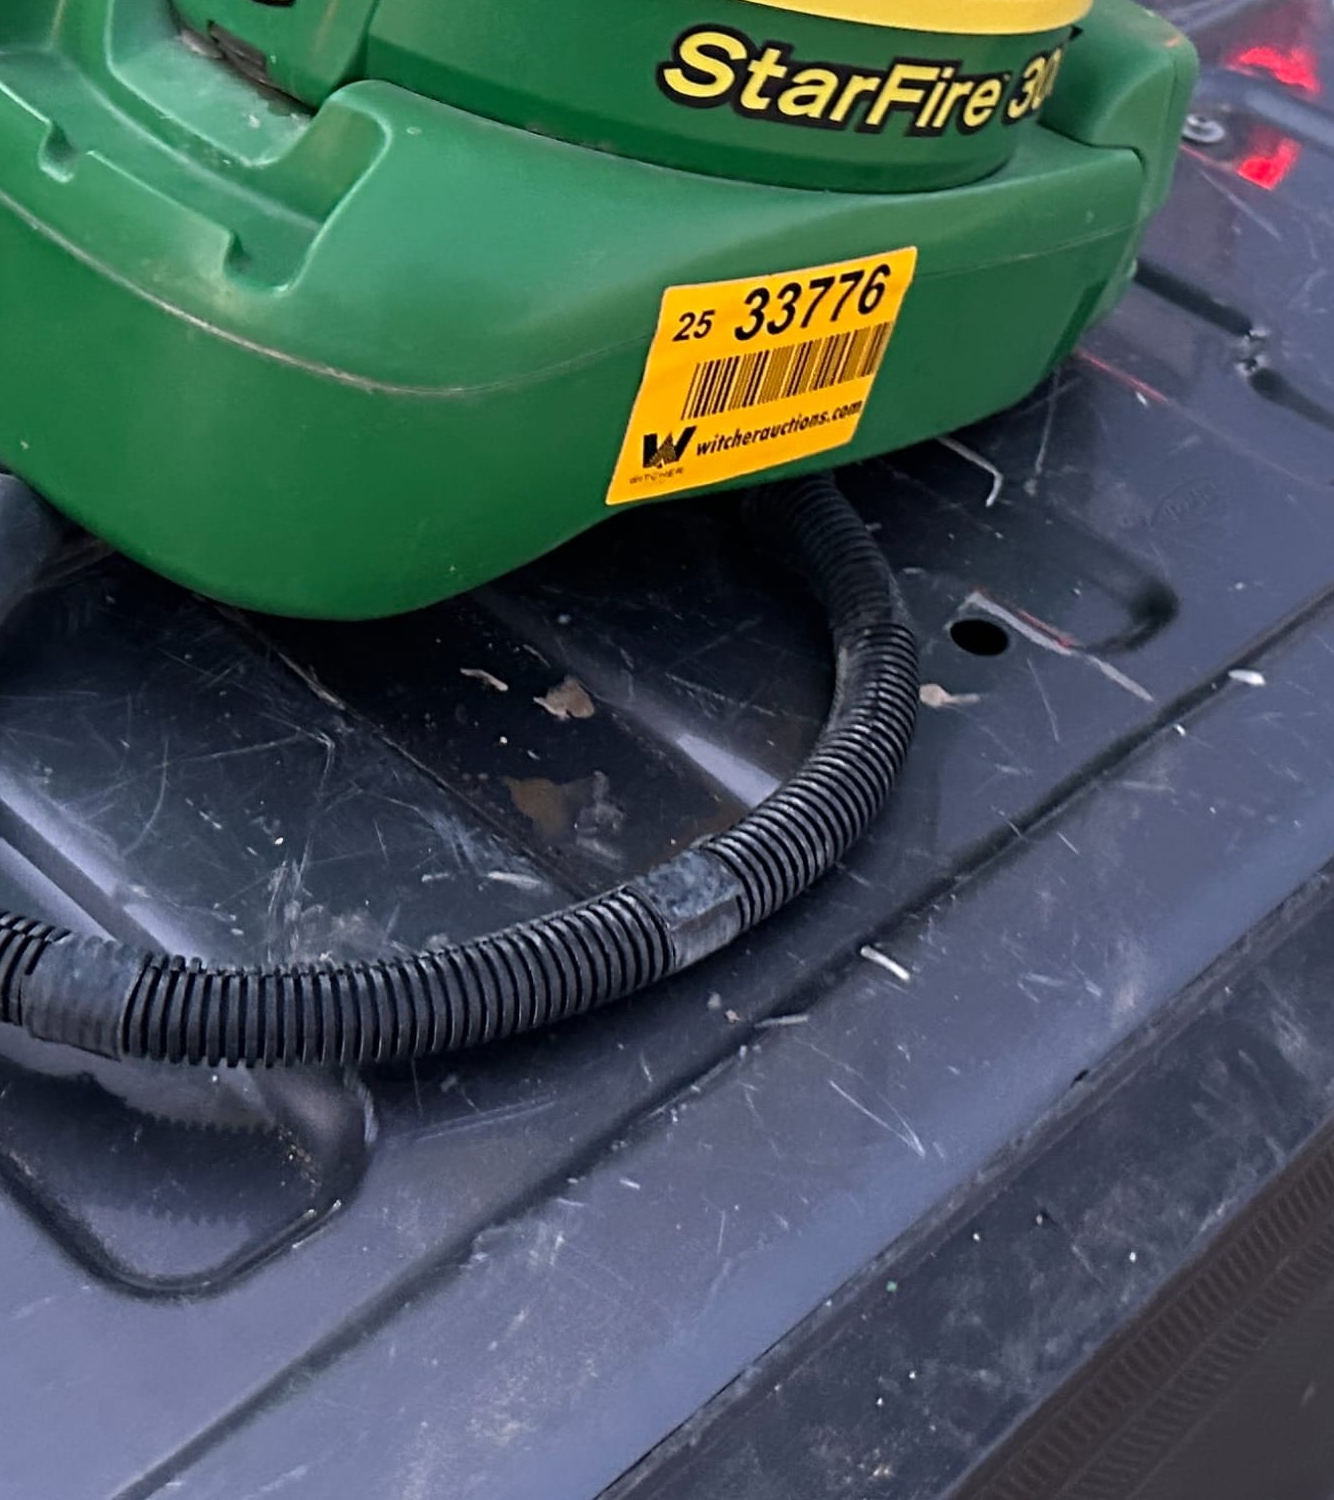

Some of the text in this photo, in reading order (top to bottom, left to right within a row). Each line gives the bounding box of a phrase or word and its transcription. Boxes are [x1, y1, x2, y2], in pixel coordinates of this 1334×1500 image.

[661, 28, 1004, 130] StarFire
[671, 263, 892, 343] 25 33776
[695, 399, 864, 457] witcherauctions.com
